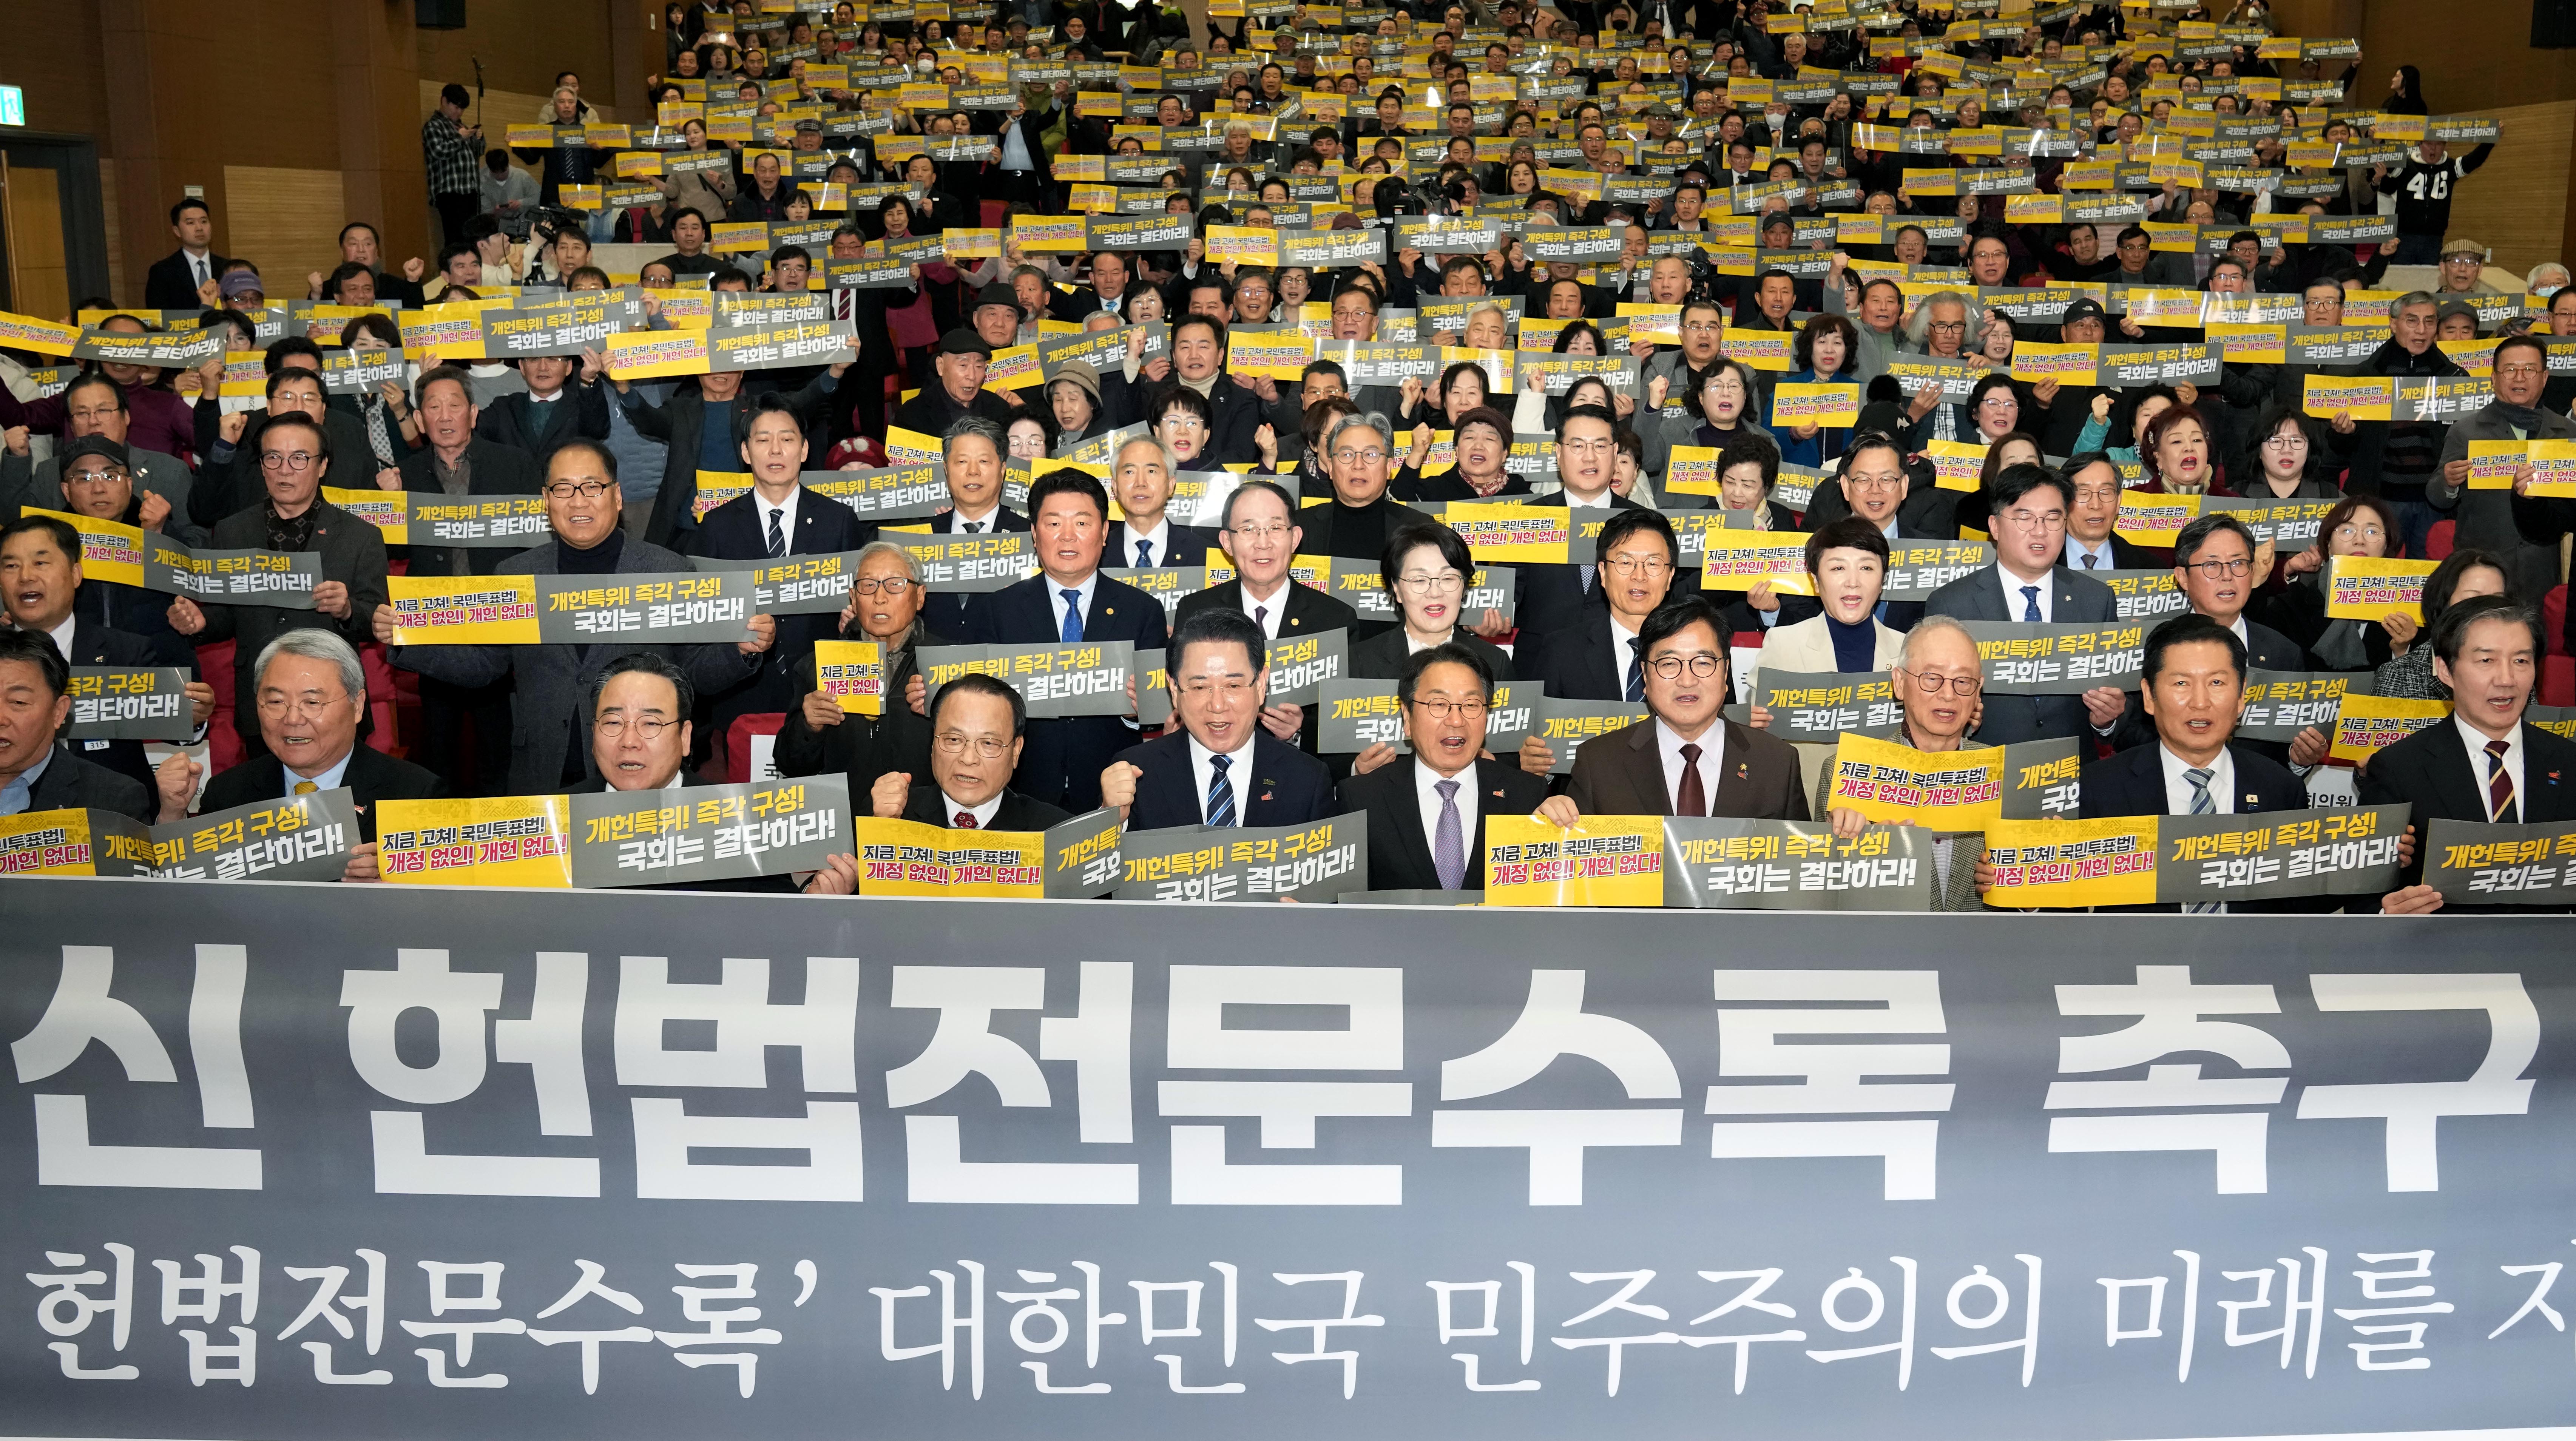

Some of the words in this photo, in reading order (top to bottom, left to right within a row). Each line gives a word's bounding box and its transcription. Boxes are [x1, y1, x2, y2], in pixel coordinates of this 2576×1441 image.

[1237, 236, 1269, 244] 국민투표법!
[1284, 237, 1324, 248] 개헌특위!
[1327, 235, 1345, 245] 즉각
[1348, 233, 1368, 243] 구성!
[1526, 232, 1567, 243] 개헌특위!
[1568, 230, 1588, 241] 즉각
[1590, 228, 1611, 239] 구성!
[2323, 230, 2350, 239] 국회는
[2353, 225, 2393, 238] 결단하라!
[1208, 244, 1223, 254] 개정
[1224, 244, 1242, 254] 없인!
[1243, 244, 1258, 253] 개헌
[1260, 244, 1277, 254] 없다!
[1295, 248, 1329, 261] 국회는
[1332, 241, 1380, 258] 결단하라!
[1537, 244, 1570, 255] 국회는
[1573, 239, 1620, 254] 결단하라!
[491, 318, 543, 335] 개헌특위!
[546, 314, 571, 327] 즉각
[575, 307, 604, 323] 구성!
[85, 336, 147, 347] 개헌특위!
[148, 336, 178, 346] 즉각
[179, 330, 208, 346] 구성!
[99, 347, 148, 357] 국회는
[152, 338, 220, 359] 결단하라!
[508, 332, 551, 350] 국회는
[556, 321, 620, 345] 결단하라!
[2308, 398, 2325, 407] 개정
[2326, 398, 2348, 407] 없인!
[2350, 396, 2368, 406] 개헌
[2369, 395, 2391, 405] 없다!
[2342, 387, 2382, 397] 국민투표법!
[1472, 521, 1497, 532] 고쳐!
[1500, 519, 1554, 531] 국민투표법!
[1478, 533, 1508, 545] 없인!
[1509, 531, 1536, 544] 개헌
[1538, 530, 1567, 543] 없다!
[154, 548, 211, 574] 개헌특위!
[216, 556, 250, 574] 즉각
[255, 555, 290, 571] 구성!
[173, 569, 223, 593] 국회는
[230, 573, 312, 592] 결단하라!
[550, 588, 630, 611] 개헌특위!
[636, 583, 673, 602] 즉각
[679, 578, 721, 599] 구성!
[395, 600, 419, 611] 지금
[422, 597, 449, 610] 고쳐!
[453, 591, 516, 606] 국민투표법!
[395, 613, 426, 627] 개정
[431, 610, 463, 625] 없인!
[468, 607, 496, 622] 개헌
[502, 604, 533, 619] 없다!
[575, 609, 641, 633] 국회는
[649, 598, 744, 628] 결단하라!
[1840, 762, 1870, 778] 지금
[1873, 767, 1908, 785] 고쳐!
[1912, 767, 1986, 788] 국민투표법!
[1838, 779, 1875, 798] 개정
[1878, 785, 1920, 805] 없인!
[1923, 788, 1960, 805] 개헌
[1963, 781, 2000, 803] 없다!
[586, 806, 689, 844] 개헌특위!
[697, 797, 744, 825] 즉각
[752, 786, 804, 817] 구성!
[105, 835, 186, 866] 개헌특위!
[193, 818, 244, 853] 즉각
[250, 807, 308, 836] 구성!
[215, 823, 344, 873] 결단하라!
[383, 832, 415, 852] 지금
[420, 828, 457, 846] 고쳐!
[461, 817, 544, 841] 국민투표법!
[618, 835, 704, 871] 국회는
[713, 809, 835, 858] 결단하라!
[1683, 836, 1780, 862] 개헌특위!
[1786, 833, 1834, 858] 즉각
[1837, 831, 1891, 858] 구성!
[2172, 828, 2271, 861] 개헌특위!
[2276, 819, 2321, 847] 즉각
[2324, 812, 2377, 840] 구성!
[0, 851, 38, 873] 개헌
[44, 844, 89, 866] 없다!
[387, 850, 424, 872] 개정
[431, 846, 473, 868] 없인!
[480, 840, 517, 862] 개헌
[523, 835, 566, 857] 없다!
[862, 845, 897, 864] 지금
[899, 847, 934, 864] 고쳐!
[938, 850, 1020, 866] 국민투표법!
[1124, 846, 1224, 882] 개헌특위!
[1231, 839, 1278, 863] 즉각
[1285, 824, 1332, 858] 구성!
[1491, 846, 1521, 862] 지금
[1524, 842, 1557, 861] 고쳐!
[1566, 836, 1641, 855] 국민투표법!
[1988, 849, 2016, 864] 지금
[2020, 846, 2055, 864] 고쳐!
[2060, 836, 2135, 859] 국민투표법!
[2201, 856, 2280, 888] 국회는
[2289, 836, 2400, 878] 결단하라!
[2441, 838, 2551, 868] 개헌특위!
[866, 862, 903, 879] 개정
[909, 864, 948, 884] 없인!
[954, 866, 991, 883] 개헌
[997, 867, 1040, 883] 없다!
[1247, 844, 1355, 893] 결단하라!
[1493, 864, 1528, 884] 개정
[1533, 861, 1573, 881] 없인!
[1579, 856, 1614, 876] 개헌
[1620, 853, 1660, 873] 없다!
[1708, 864, 1790, 894] 국회는
[1800, 858, 1917, 890] 결단하라!
[1988, 867, 2023, 885] 개정
[2028, 864, 2070, 883] 없인!
[2074, 857, 2108, 878] 개헌
[2114, 852, 2153, 873] 없다!
[2469, 865, 2556, 892] 국회는
[8, 942, 264, 1191] 신
[340, 949, 1956, 1206] 헌법전문수록
[2044, 966, 2540, 1194] 촉구
[868, 1260, 1385, 1400] 대한민국
[1426, 1254, 2042, 1397] 민주주의의
[2095, 1246, 2454, 1383] 미래를
